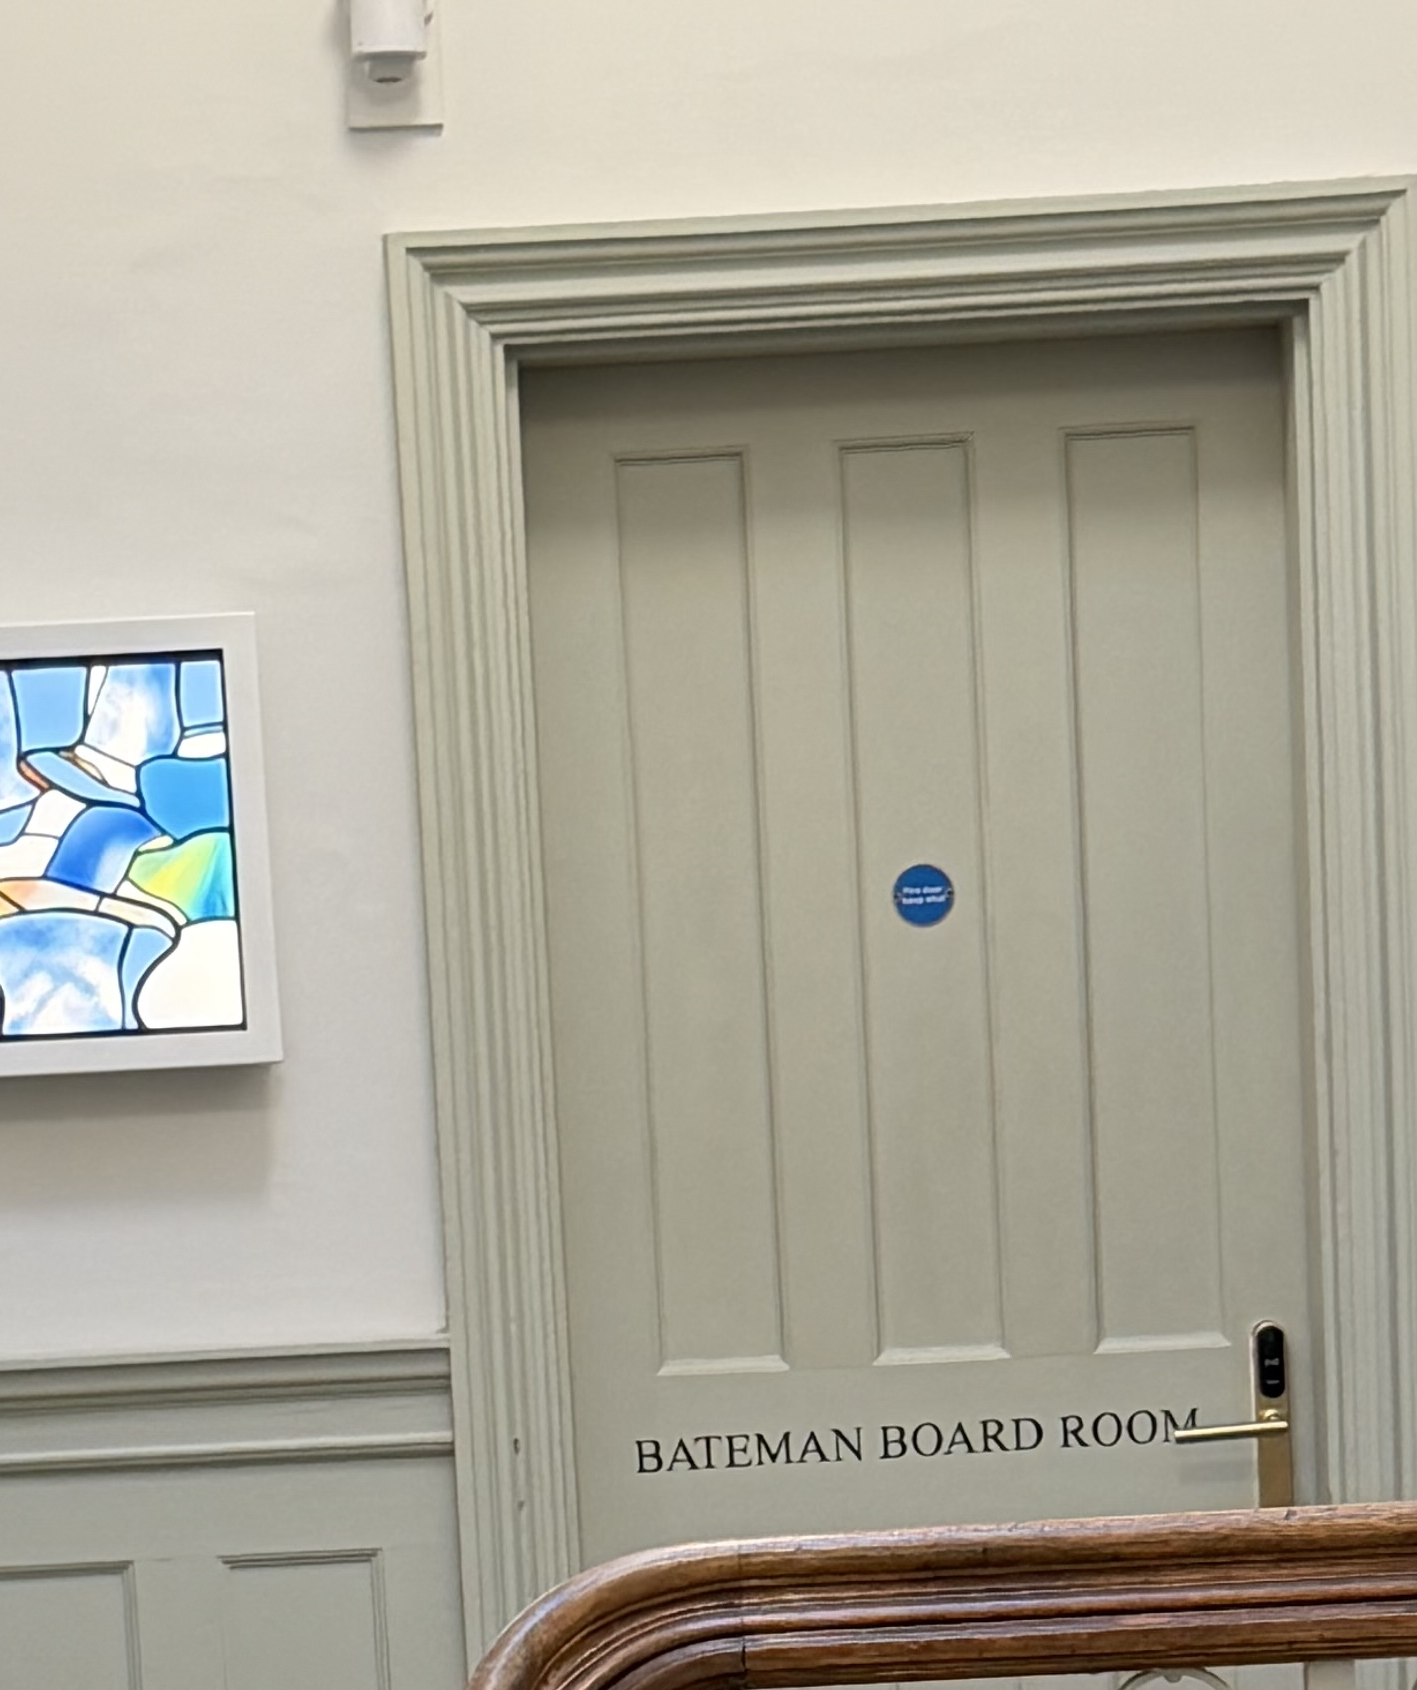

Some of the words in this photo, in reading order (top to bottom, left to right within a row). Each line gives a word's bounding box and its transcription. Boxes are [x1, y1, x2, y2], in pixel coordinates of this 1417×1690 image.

[636, 1426, 863, 1474] BATEMAN
[880, 1417, 1044, 1461] BOARD
[1059, 1408, 1199, 1450] ROOM
